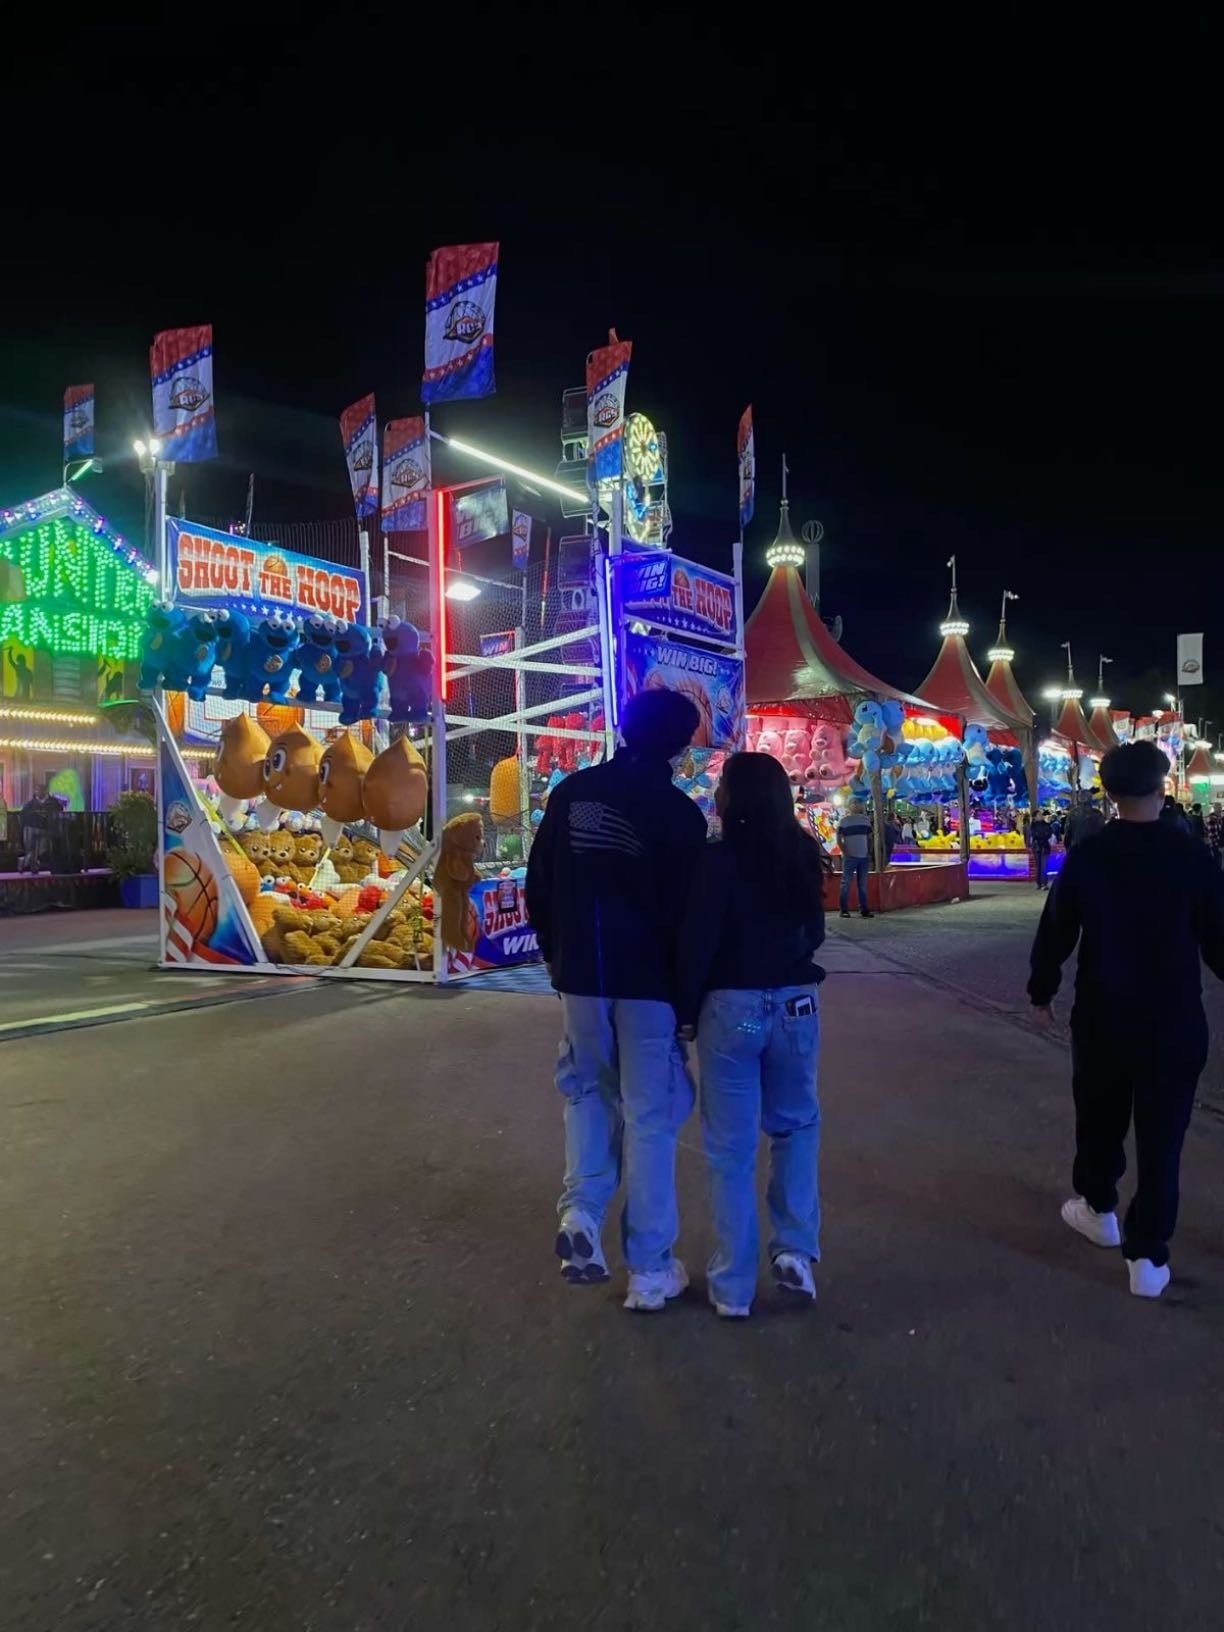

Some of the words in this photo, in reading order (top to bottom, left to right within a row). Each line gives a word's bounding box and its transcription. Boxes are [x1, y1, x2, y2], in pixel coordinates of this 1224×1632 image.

[178, 533, 254, 593] SHOOT
[259, 571, 293, 600] THE
[296, 565, 361, 624] HOOP
[671, 585, 692, 612] THE
[695, 578, 733, 633] HOOP
[656, 645, 687, 670] WIN
[687, 655, 718, 677] BIG!
